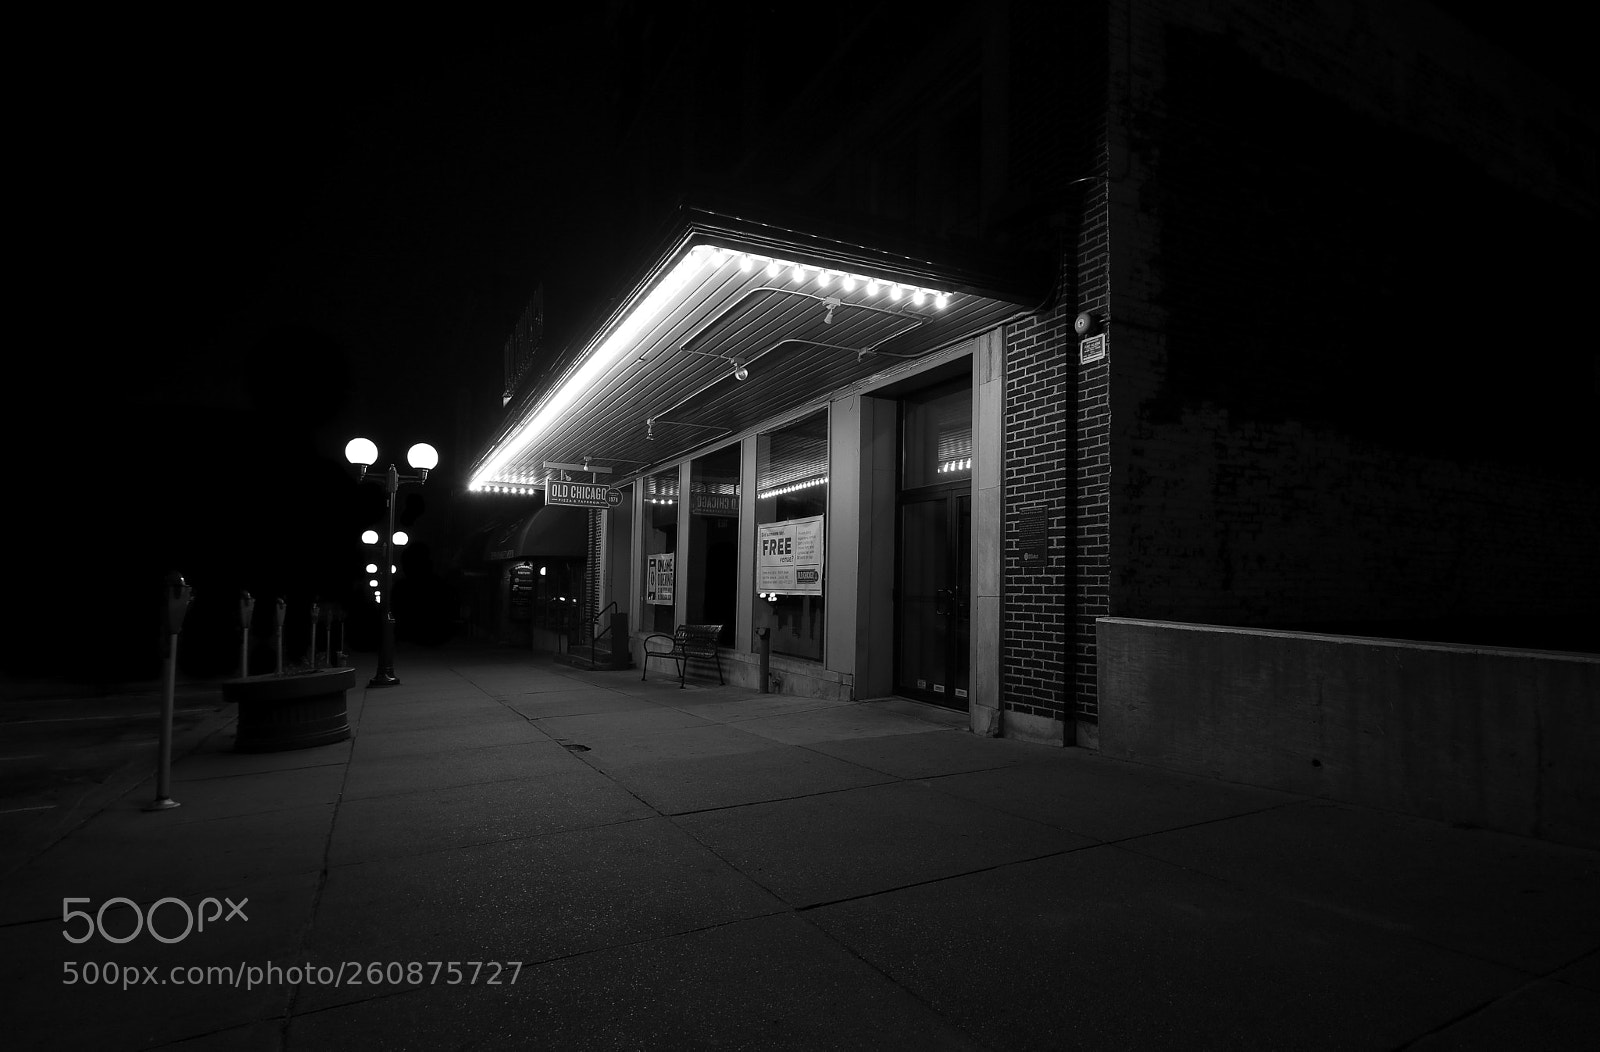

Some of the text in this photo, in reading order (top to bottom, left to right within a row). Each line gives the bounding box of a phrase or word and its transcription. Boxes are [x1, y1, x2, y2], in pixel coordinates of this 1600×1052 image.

[552, 484, 606, 500] OLD CHICAGO
[762, 537, 792, 556] FREE
